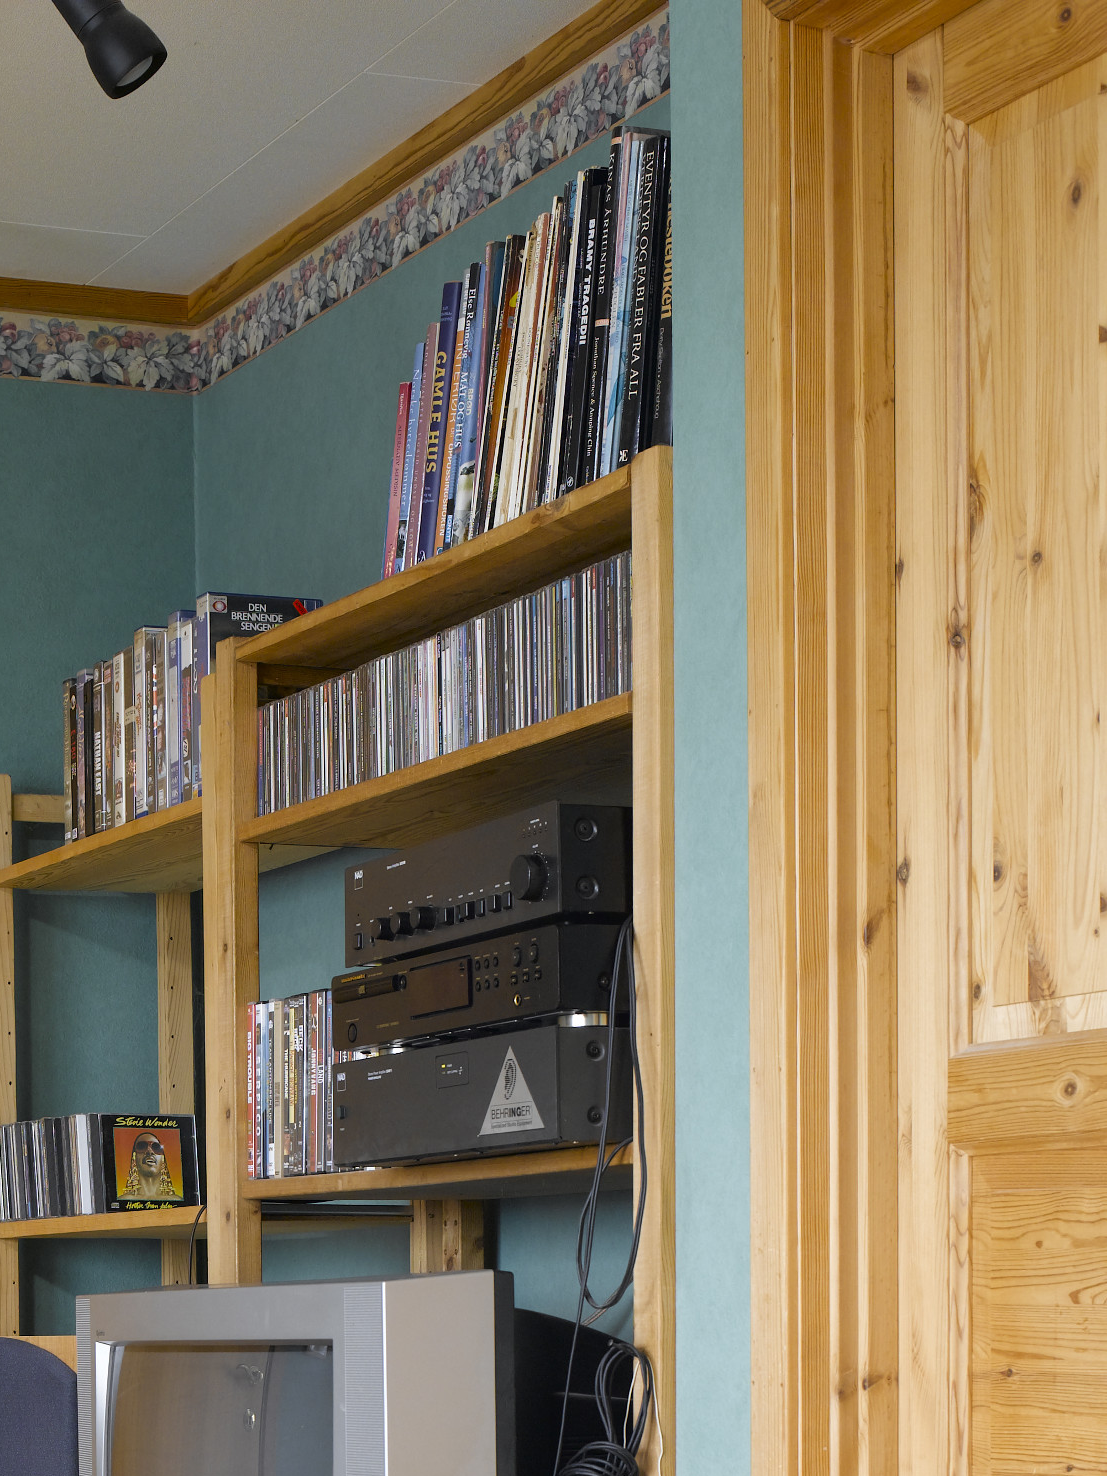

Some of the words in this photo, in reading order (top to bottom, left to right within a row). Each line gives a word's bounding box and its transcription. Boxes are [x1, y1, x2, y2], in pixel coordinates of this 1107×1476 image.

[605, 153, 615, 203] KINAS
[641, 151, 654, 233] EVENTYR
[585, 218, 596, 272] BRAMY
[598, 208, 612, 295] ÅRHUNDRE
[639, 236, 649, 262] OG
[467, 288, 476, 308] Else
[579, 274, 592, 345] TRAGEDII
[634, 266, 647, 328] FABLER
[461, 312, 474, 359] Rønnevig
[631, 332, 642, 364] FRA
[432, 351, 447, 422] GAMLE
[458, 372, 468, 398] MAT
[628, 369, 639, 400] ALL
[457, 402, 465, 420] OG
[466, 388, 474, 416] BRØD
[454, 423, 464, 448] HUS
[426, 430, 440, 473] HUS
[231, 611, 284, 623] BRENNENDE
[248, 603, 267, 613] DEN
[94, 771, 102, 796] EAST
[113, 1117, 143, 1126] Stevie
[145, 1117, 178, 1128] Wonder
[491, 1105, 531, 1120] BEHRINGER
